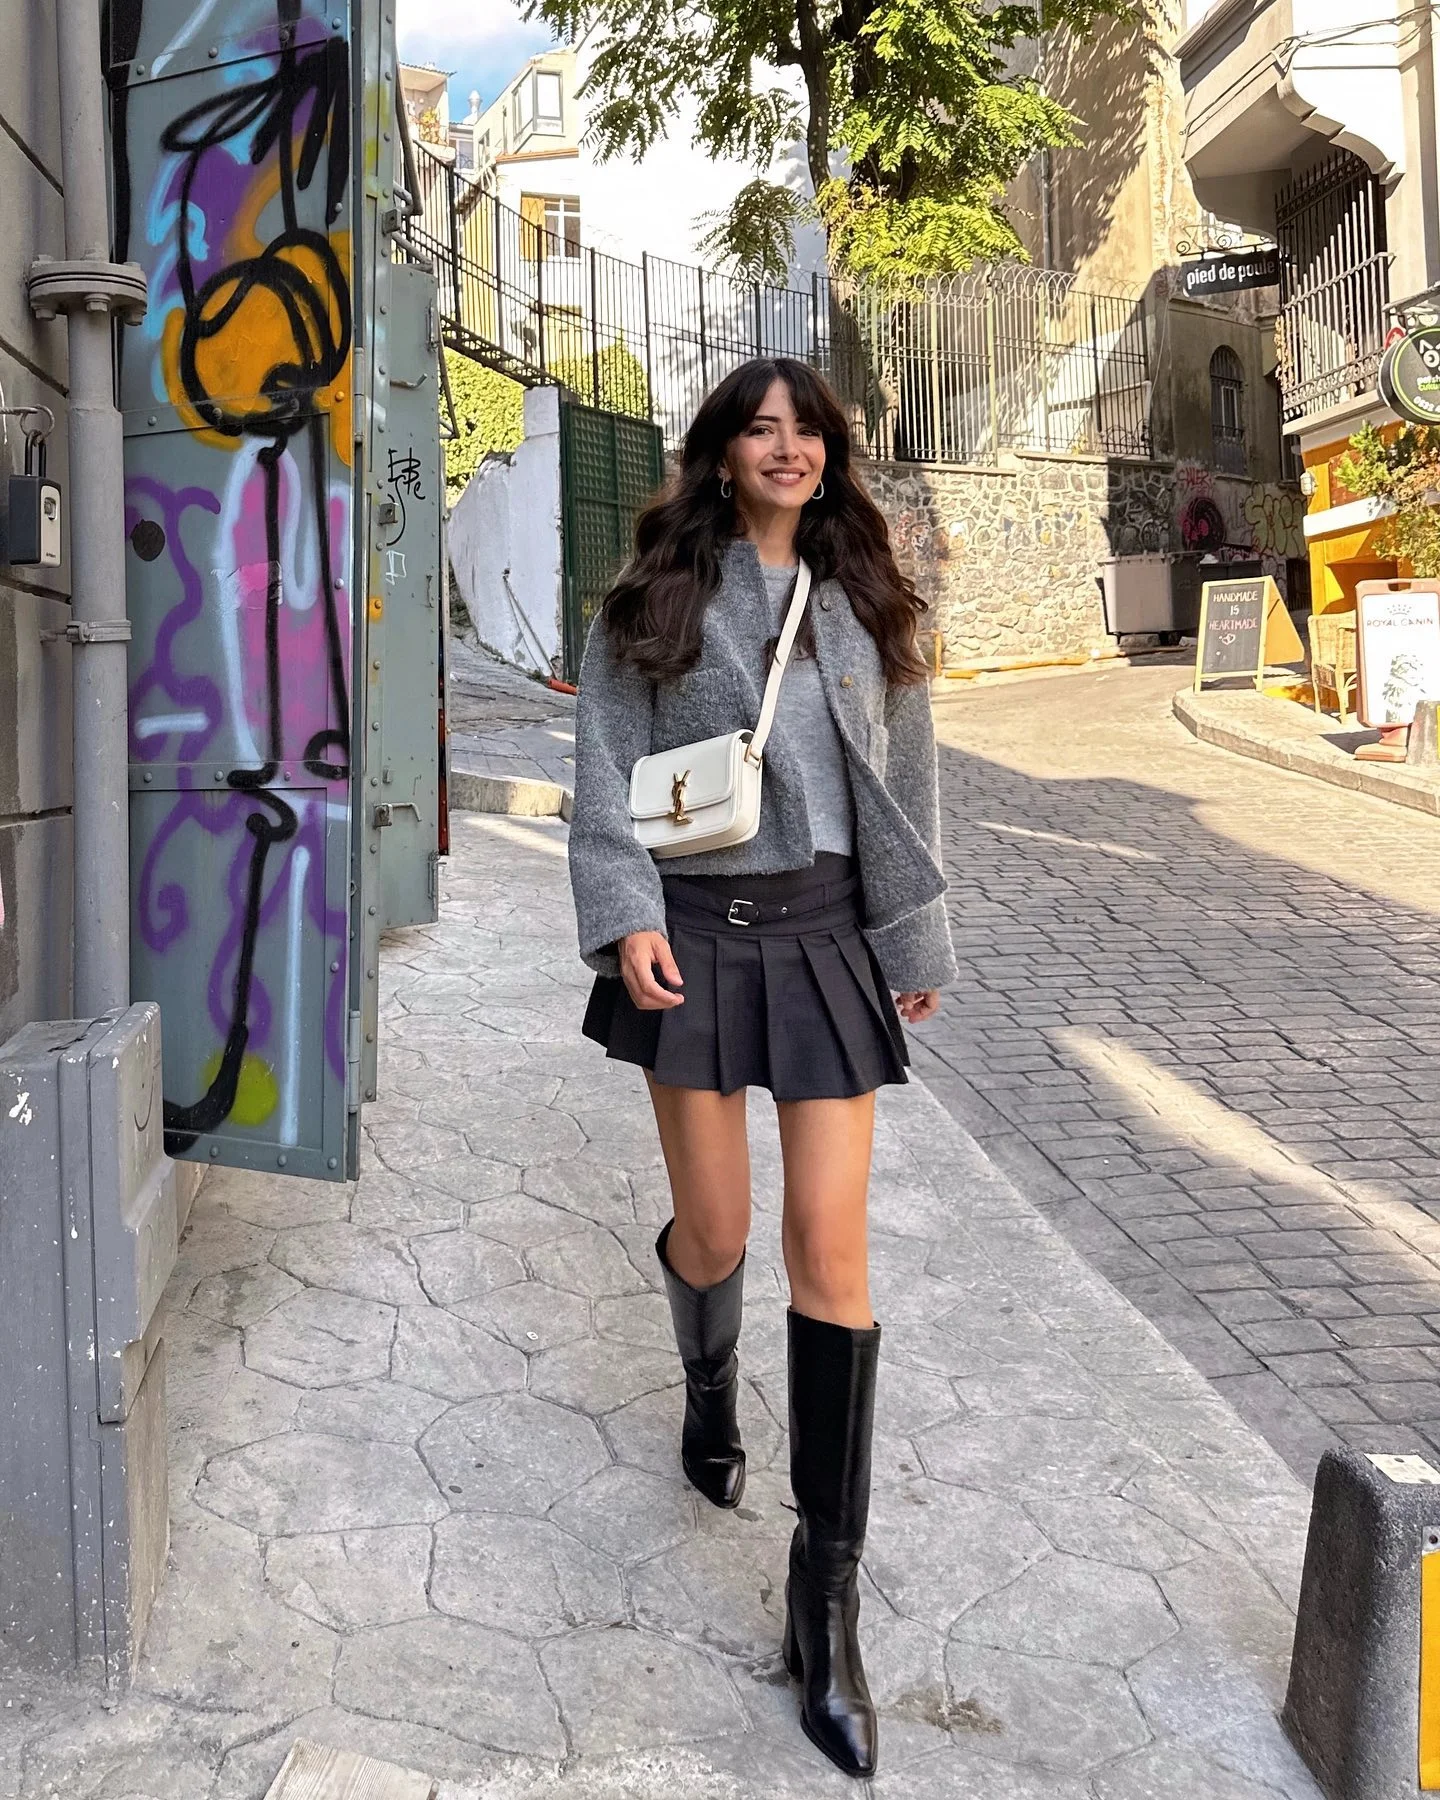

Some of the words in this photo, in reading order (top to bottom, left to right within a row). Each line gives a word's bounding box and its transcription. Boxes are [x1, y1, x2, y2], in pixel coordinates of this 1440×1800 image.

[1186, 264, 1216, 290] pied
[1218, 262, 1236, 281] de
[1237, 257, 1275, 283] poule
[1213, 590, 1258, 603] HANDMADE
[1230, 604, 1240, 616] IS
[1208, 617, 1258, 631] HEARTMADE
[1366, 619, 1400, 628] ROYAL
[1400, 617, 1434, 627] CANIN
